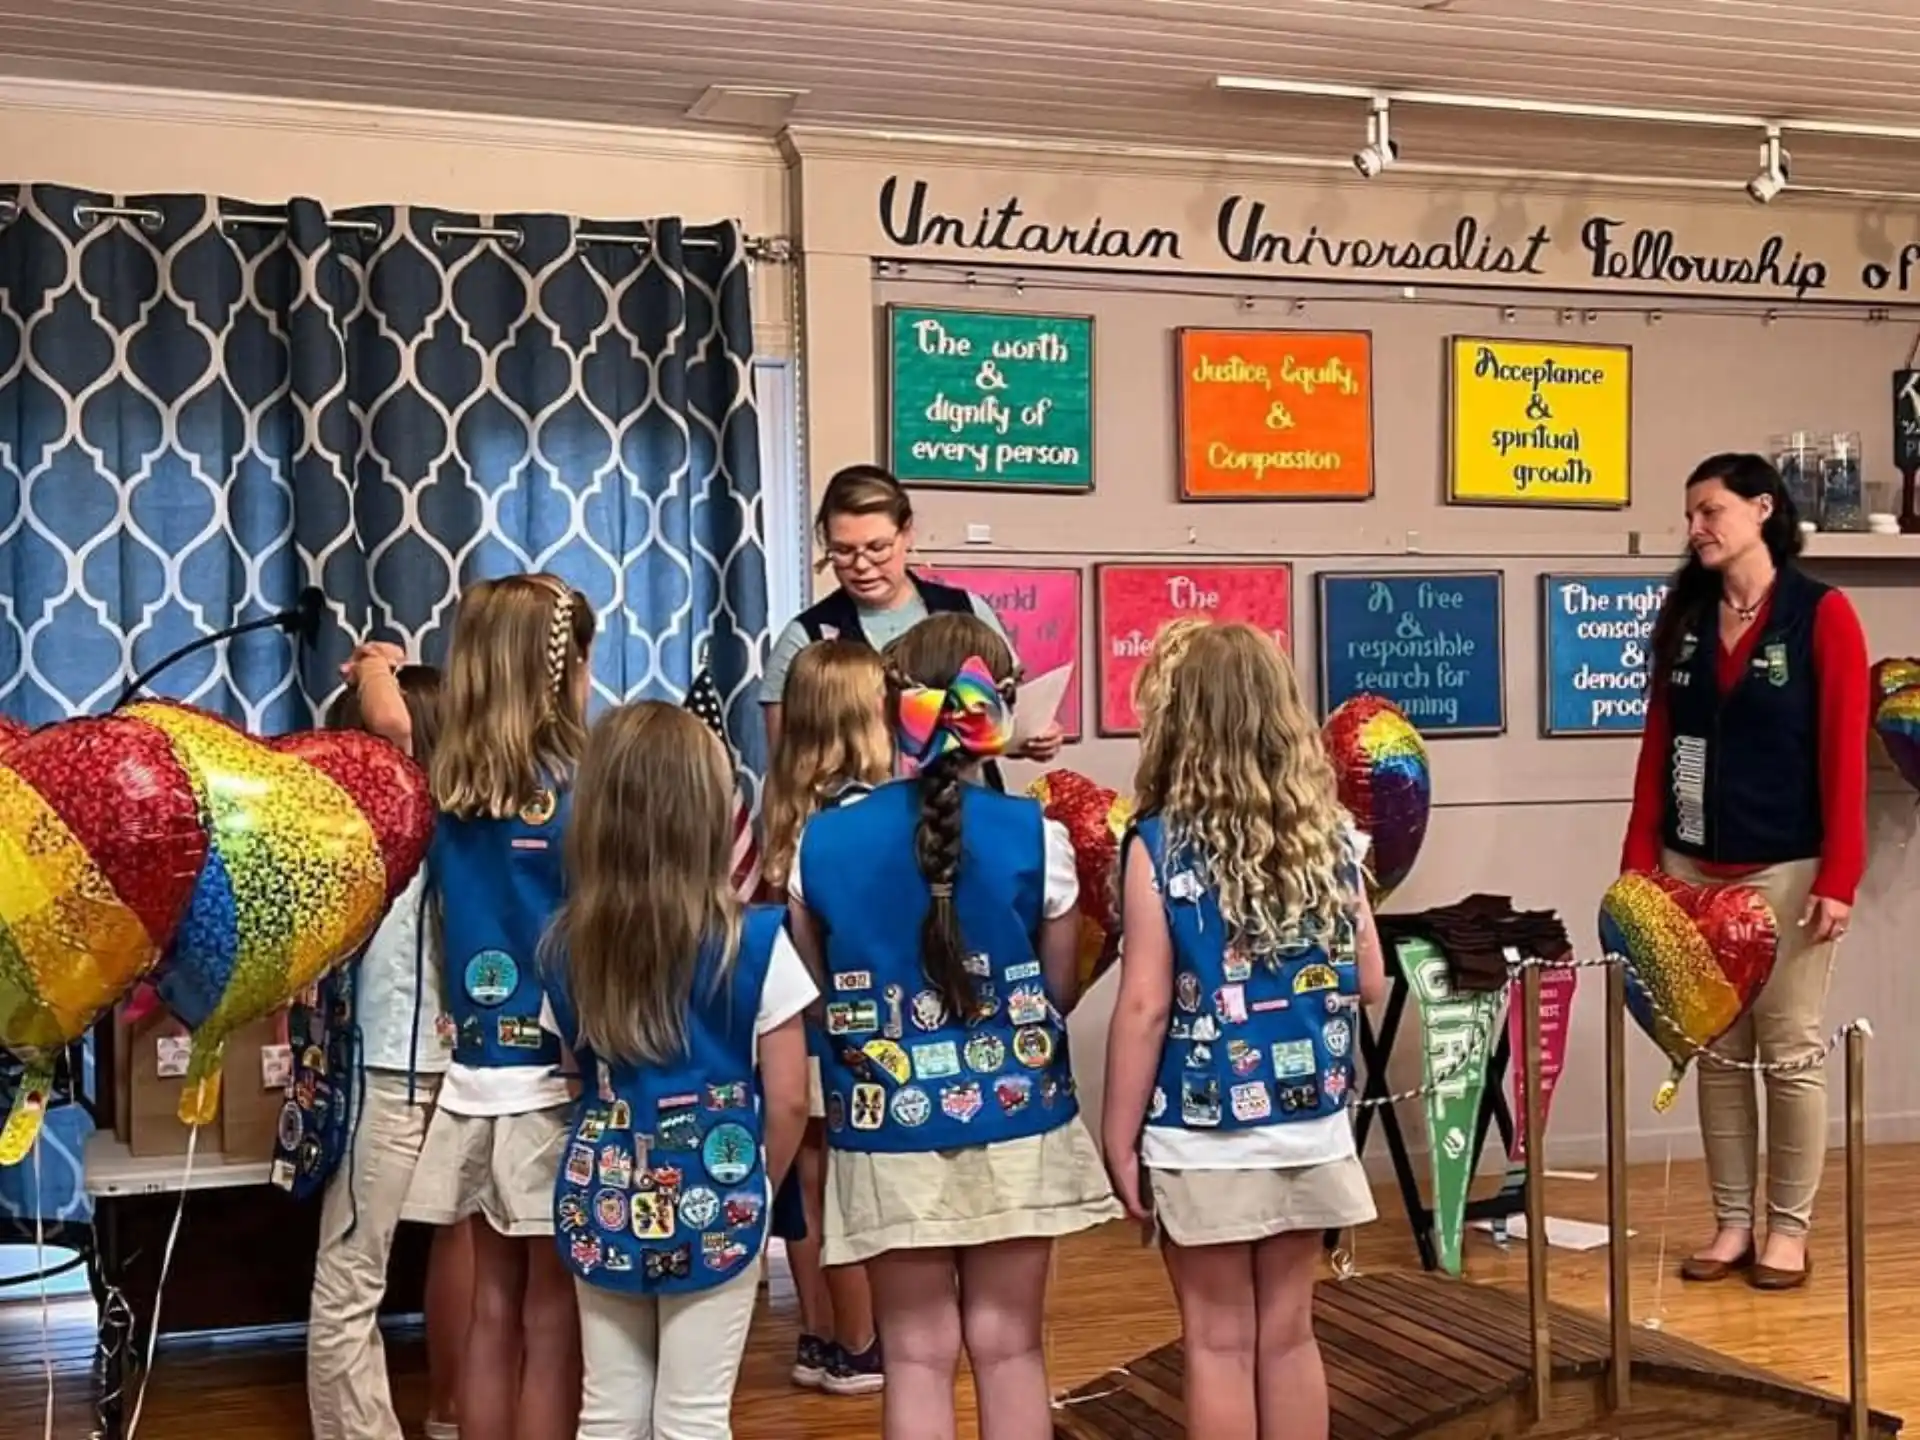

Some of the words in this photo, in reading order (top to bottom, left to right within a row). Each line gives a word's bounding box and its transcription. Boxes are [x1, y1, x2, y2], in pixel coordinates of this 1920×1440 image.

[880, 175, 1183, 259] Unitarian
[1217, 195, 1550, 274] Universalist
[1581, 216, 1827, 297] Fellowship
[1861, 243, 1920, 291] of
[912, 319, 972, 357] The
[991, 332, 1069, 363] worth
[975, 359, 1009, 390] &
[1192, 354, 1272, 392] Justice,
[1280, 354, 1359, 395] Equity,
[1474, 346, 1604, 392] Acceptance
[925, 392, 1010, 434] dignity
[1021, 397, 1053, 427] of
[1265, 400, 1296, 429] &
[1525, 392, 1553, 420] &
[1491, 424, 1580, 457] spiritual
[911, 441, 990, 472] every
[995, 443, 1080, 473] person
[1207, 441, 1342, 480] Compassion
[1513, 458, 1592, 490] growth
[1165, 575, 1220, 609] The
[1368, 581, 1394, 614] A
[1418, 581, 1464, 608] free
[1559, 583, 1610, 614] The
[1396, 611, 1424, 639] &
[1577, 620, 1654, 640] conscie
[1348, 630, 1476, 667] responsible
[1620, 640, 1645, 668] &
[1355, 662, 1430, 689] search
[1436, 661, 1471, 688] for
